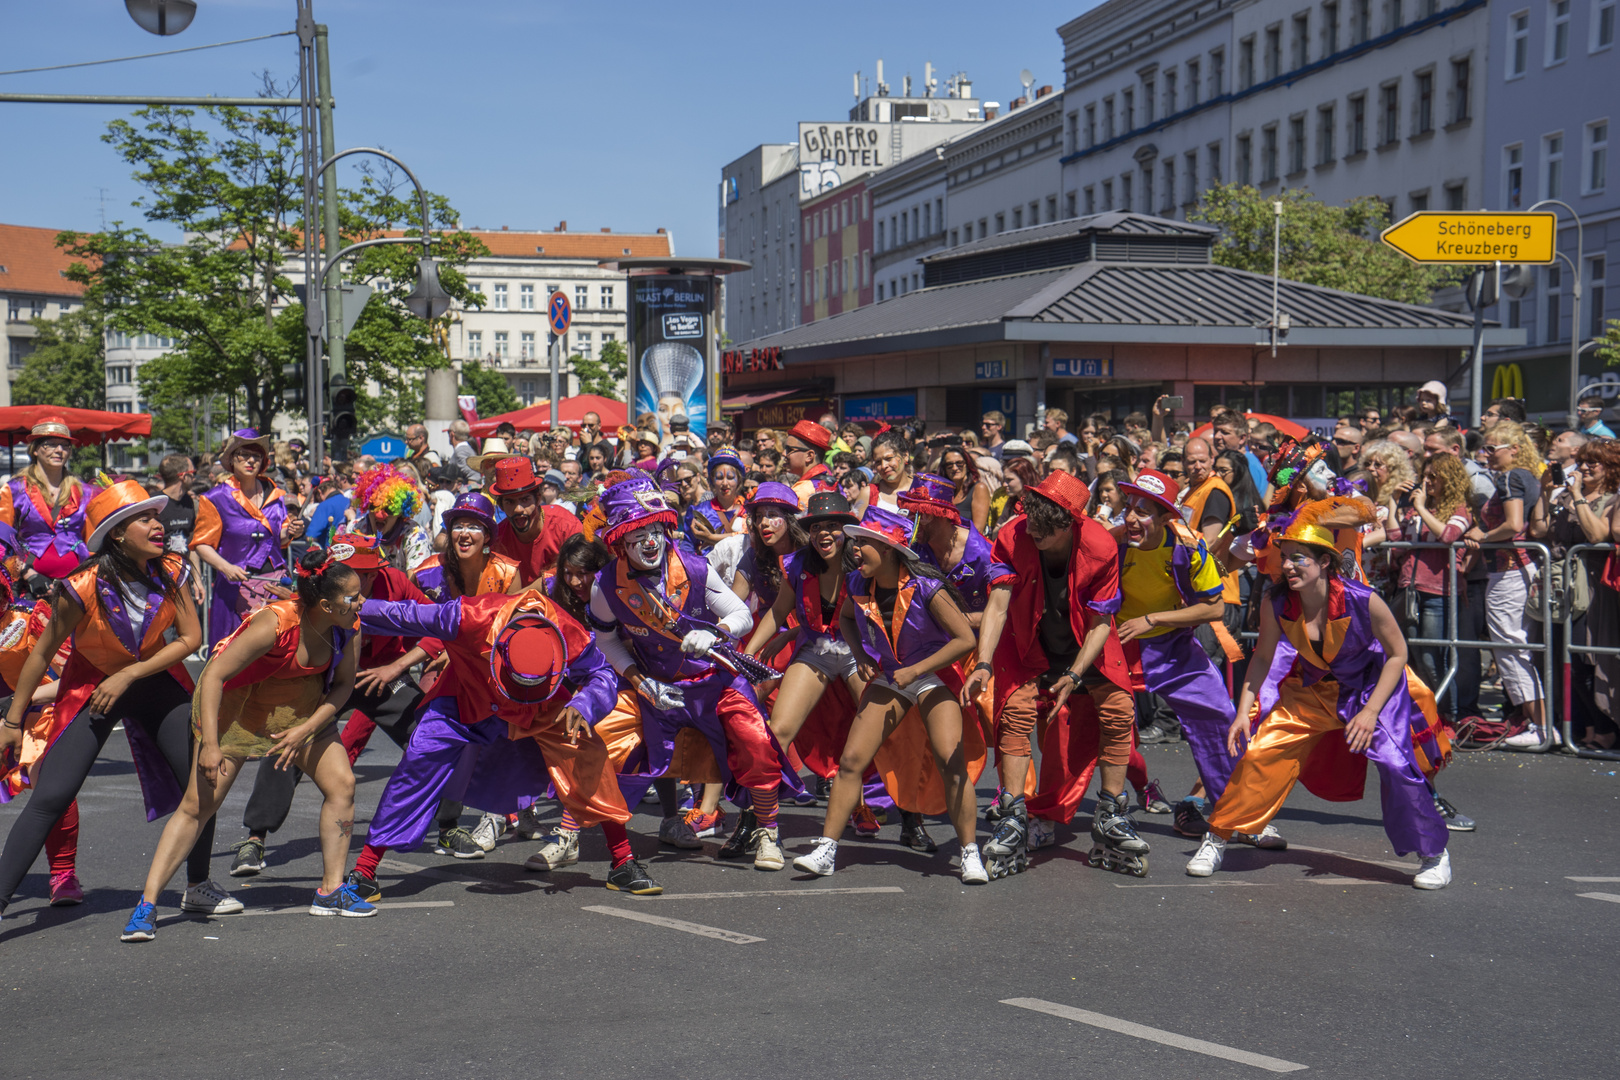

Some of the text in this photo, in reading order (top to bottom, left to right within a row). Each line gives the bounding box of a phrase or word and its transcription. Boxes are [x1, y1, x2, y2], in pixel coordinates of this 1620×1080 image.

[803, 125, 878, 152] GRAFRO
[820, 148, 883, 166] HOTEL
[1438, 221, 1531, 239] Schöneberg
[1436, 241, 1518, 258] Kreuzberg
[674, 292, 704, 302] BERLIN
[751, 346, 780, 372] BOX
[1070, 359, 1081, 375] U
[757, 405, 805, 426] CHINA BOX
[381, 441, 391, 454] U
